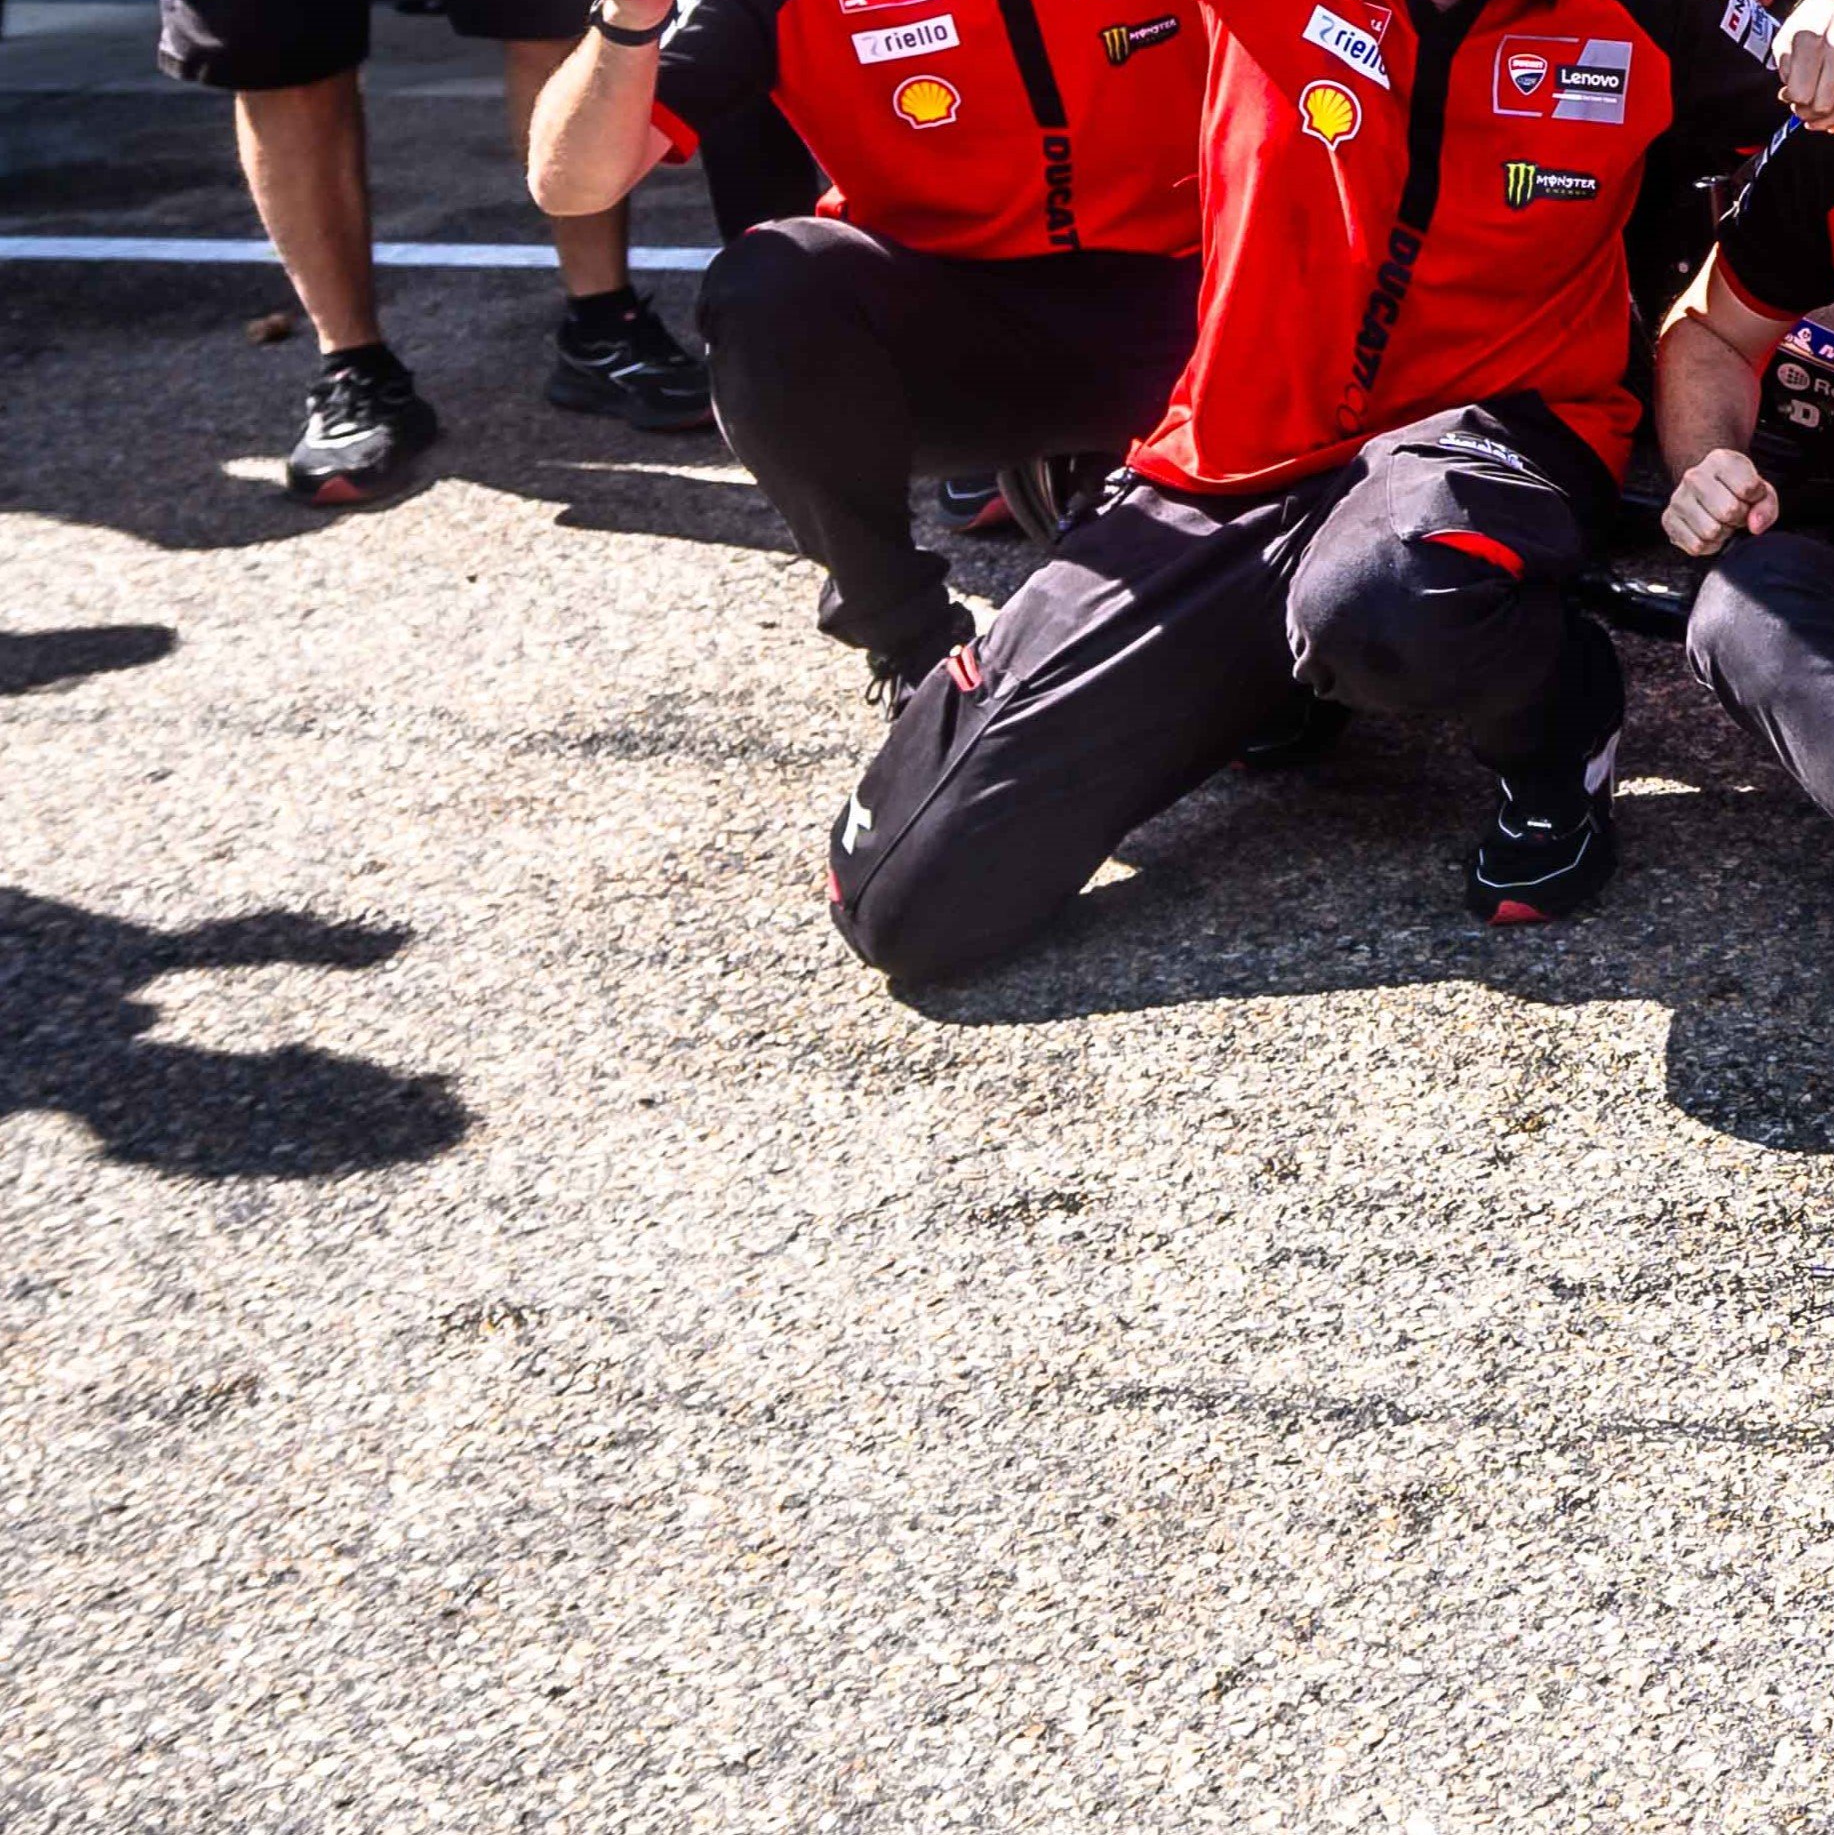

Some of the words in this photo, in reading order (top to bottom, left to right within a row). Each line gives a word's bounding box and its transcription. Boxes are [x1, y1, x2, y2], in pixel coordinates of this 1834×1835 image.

[884, 24, 948, 51] riello
[1130, 19, 1178, 41] MONSTER
[1562, 69, 1619, 87] Lenovo
[1044, 135, 1079, 249] DUCAT
[1537, 175, 1595, 189] MONSTER
